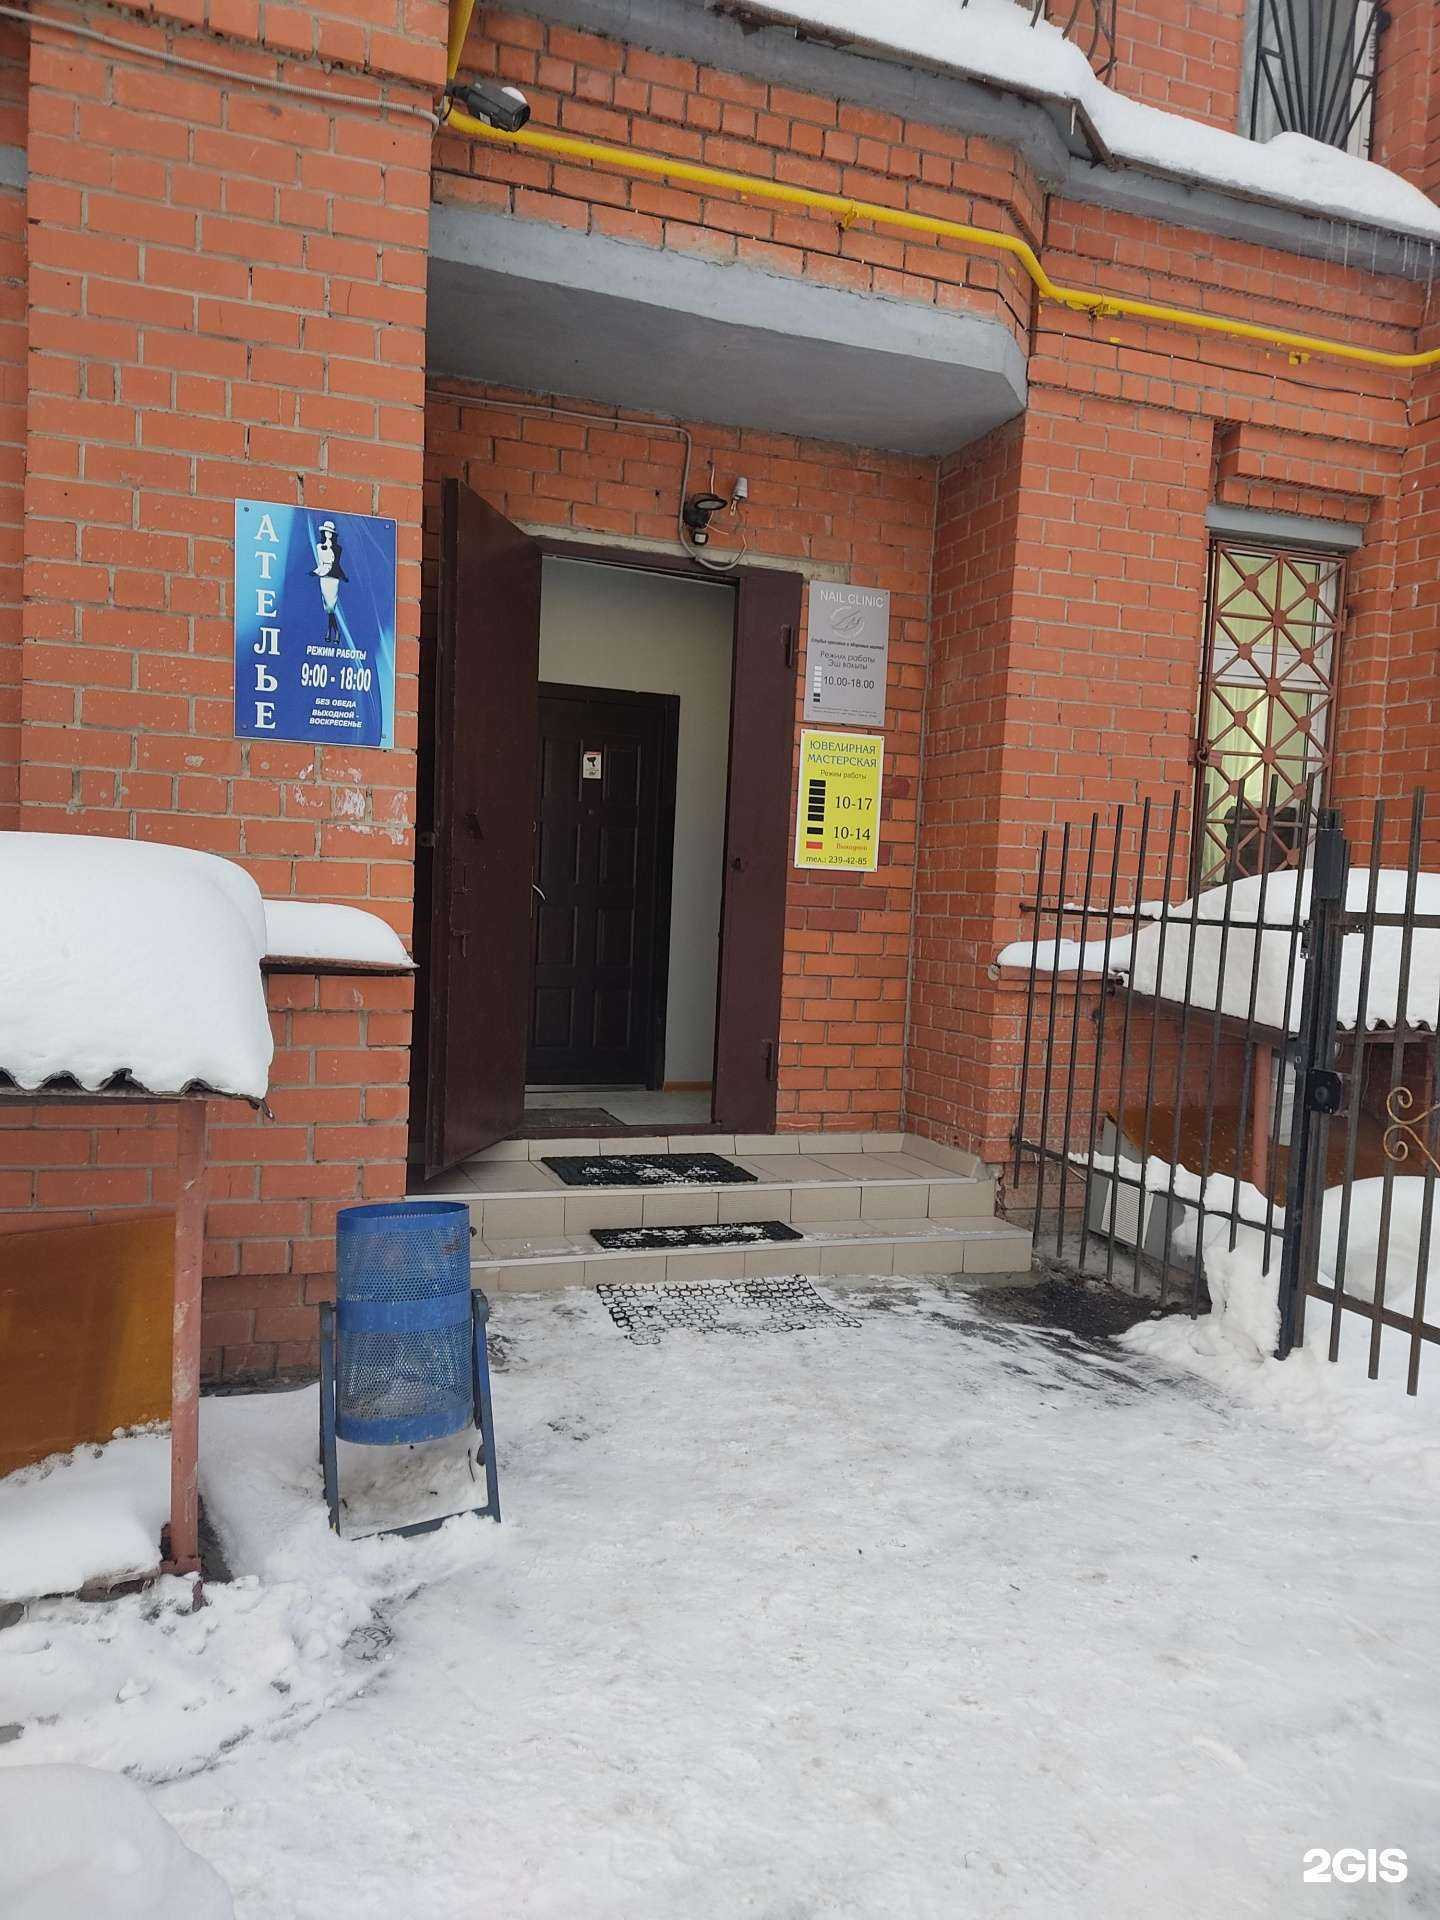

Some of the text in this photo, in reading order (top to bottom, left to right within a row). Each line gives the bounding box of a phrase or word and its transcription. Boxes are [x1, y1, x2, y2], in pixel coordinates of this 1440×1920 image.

[820, 590, 884, 608] NAIL CLINIC
[253, 513, 281, 730] АТЕЛЬЕ
[306, 645, 367, 660] РЕЖИМ РАБОТЫ
[820, 650, 876, 665] Режим работы
[301, 662, 328, 688] 9:00
[340, 666, 371, 692] 18:00
[824, 676, 875, 690] 10.00-18.00
[315, 697, 357, 708] БЕЗ ОБЕДА
[312, 709, 355, 719] ВЫХОДНОЙ
[309, 717, 362, 728] ВОСКРЕСЕНЬЕ
[810, 740, 876, 755] ЮВЕЛИРНАЯ
[807, 753, 877, 768] МАСТЕРСКАЯ
[820, 769, 867, 780] Режим работы
[835, 796, 873, 811] 10-17
[833, 826, 871, 841] 10-14
[828, 855, 868, 865] 239-42-85
